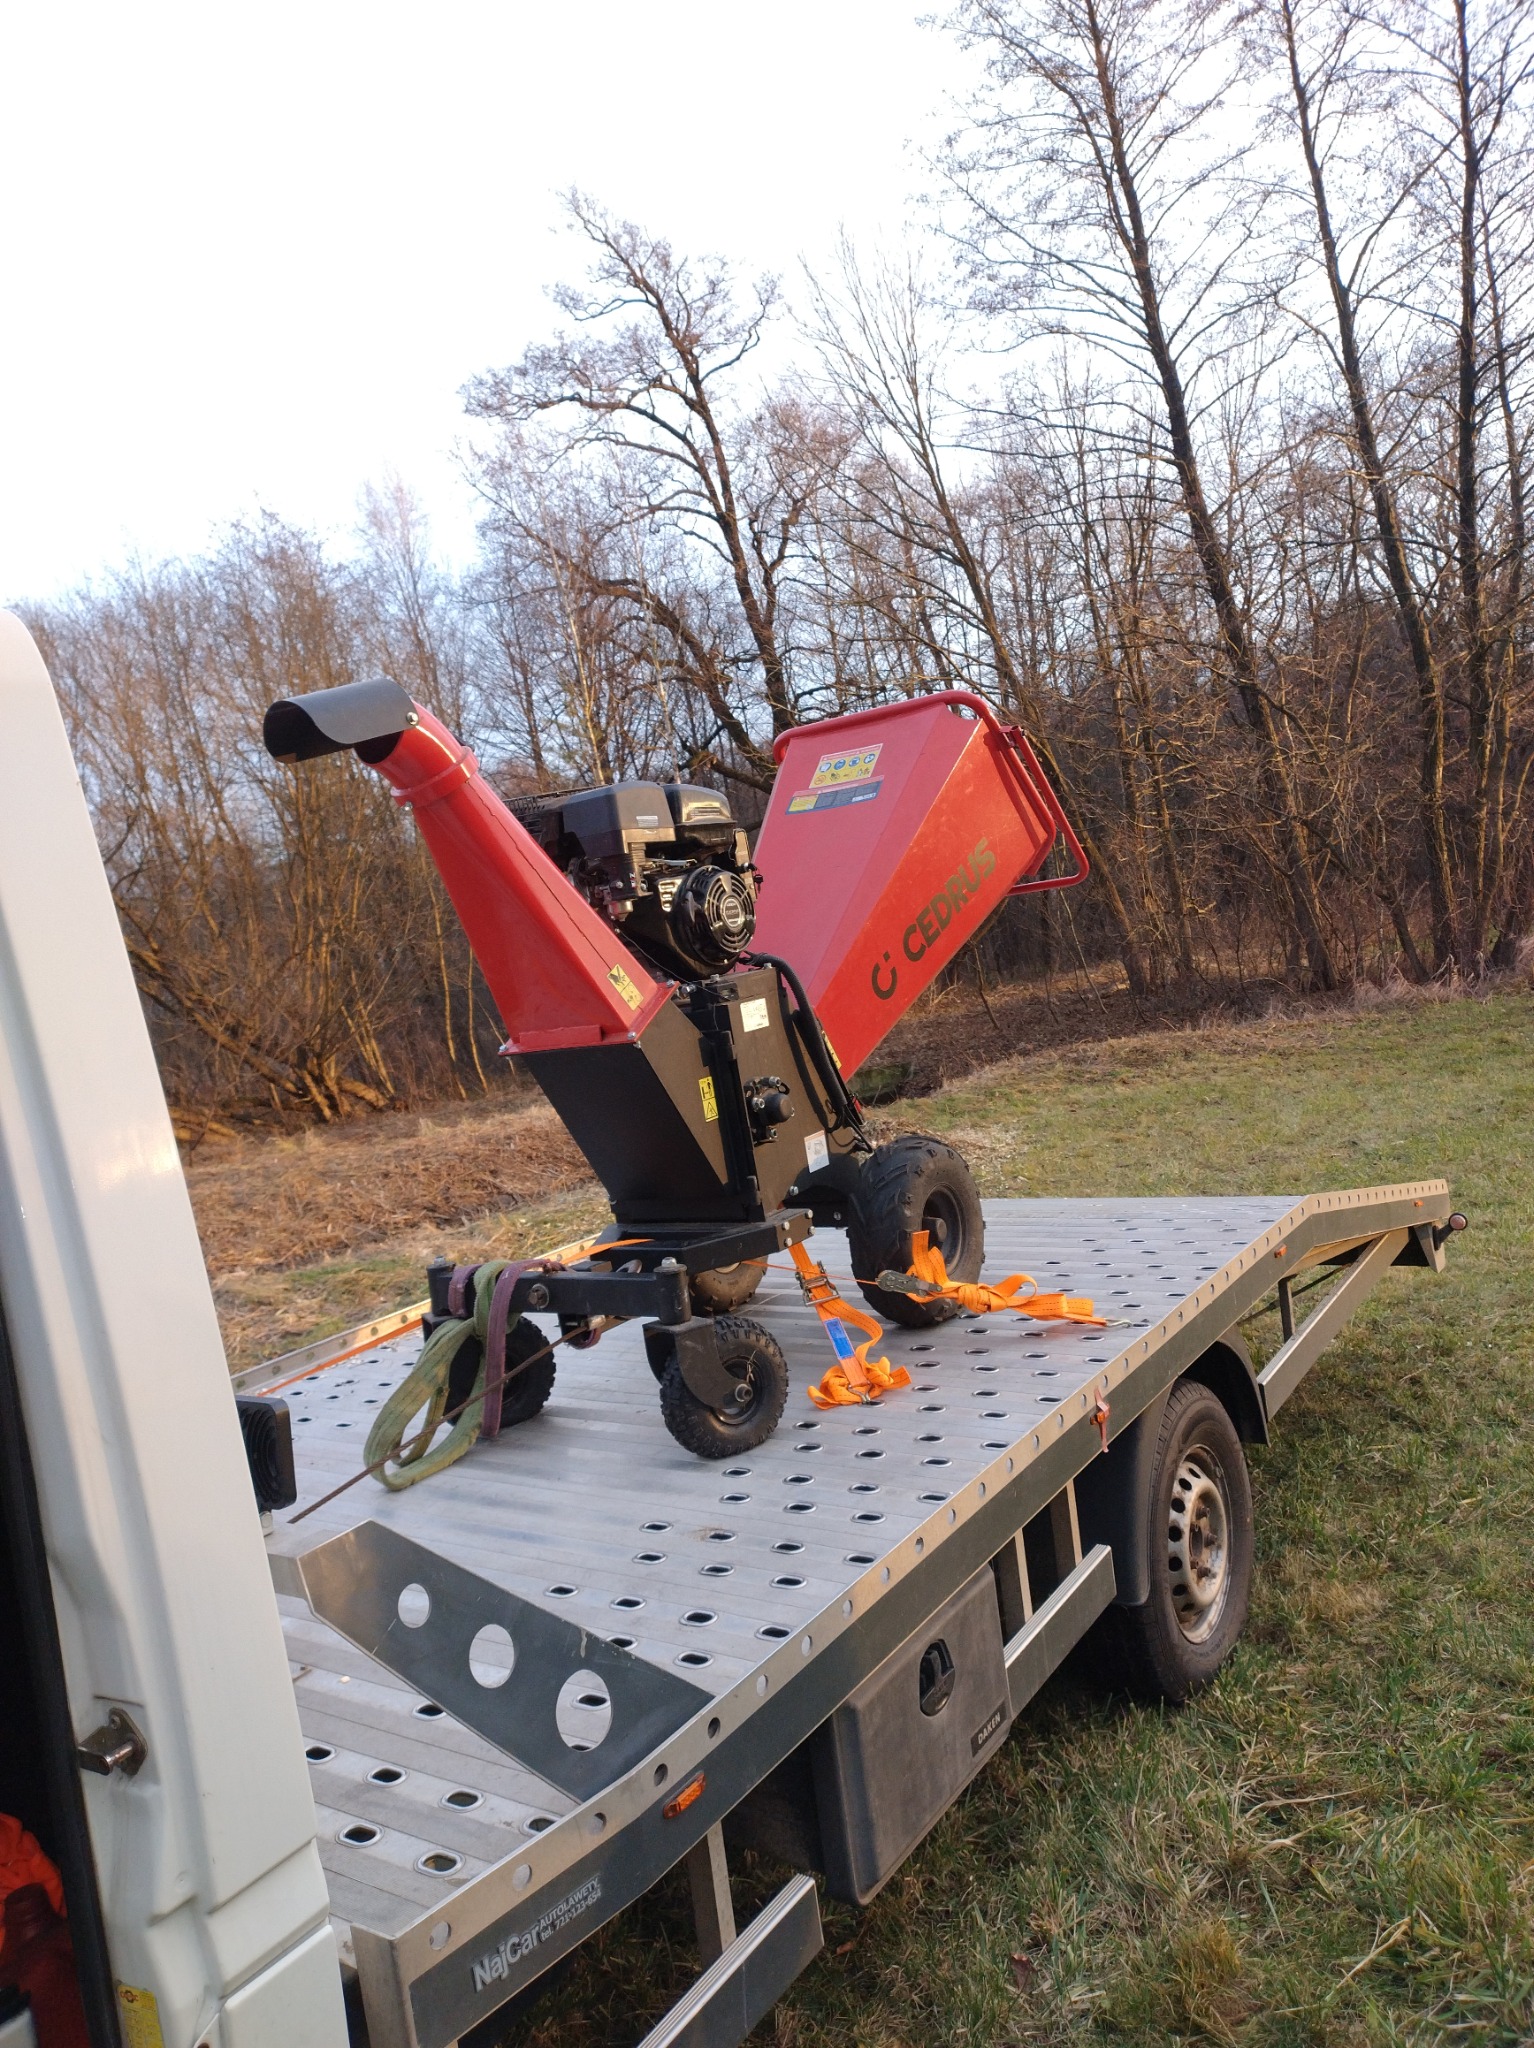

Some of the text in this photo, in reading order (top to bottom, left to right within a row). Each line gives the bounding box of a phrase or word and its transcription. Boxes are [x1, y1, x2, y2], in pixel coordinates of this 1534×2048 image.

[903, 838, 996, 962] CEDRUS
[978, 1711, 1001, 1745] DAKEN
[472, 1926, 540, 1992] NajCar
